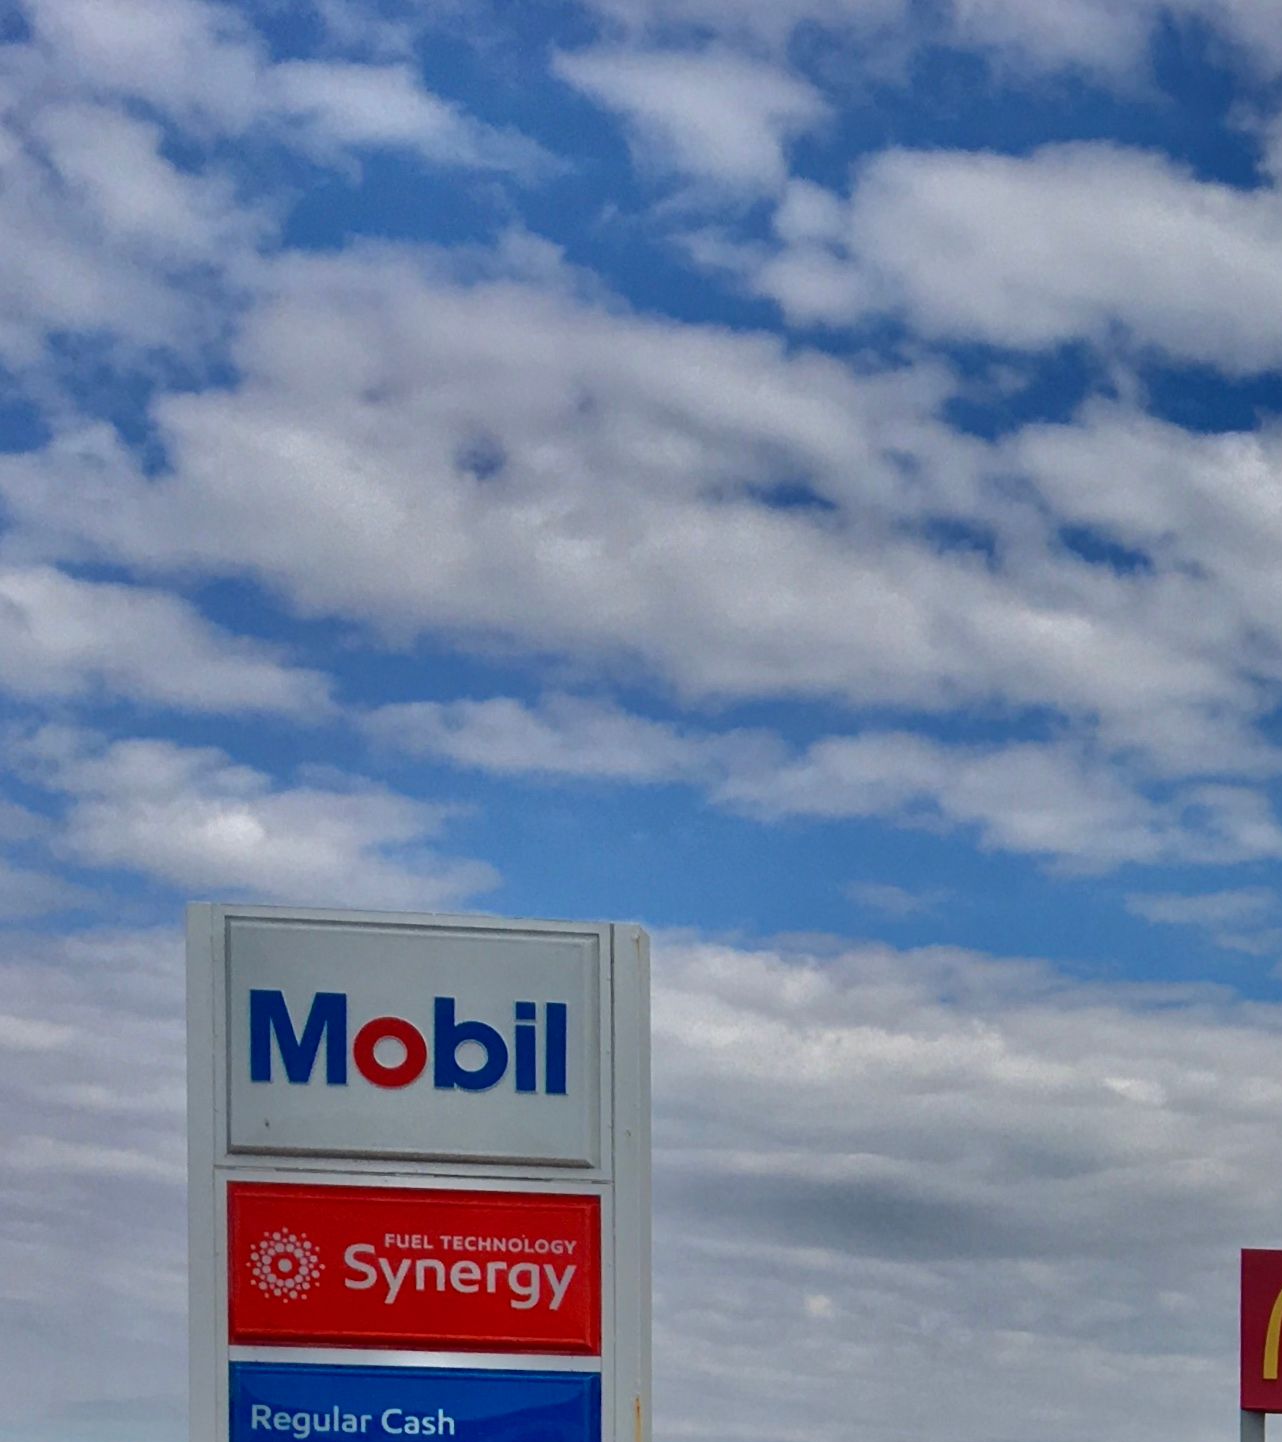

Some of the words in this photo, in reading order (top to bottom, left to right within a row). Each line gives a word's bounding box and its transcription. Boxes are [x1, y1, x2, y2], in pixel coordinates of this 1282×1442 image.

[249, 989, 568, 1096] Mobil
[385, 1233, 433, 1249] FUEL
[440, 1235, 578, 1255] TECHNOLOGY
[344, 1243, 577, 1311] Synergy
[251, 1404, 372, 1439] Regular
[381, 1408, 456, 1436] Cash
